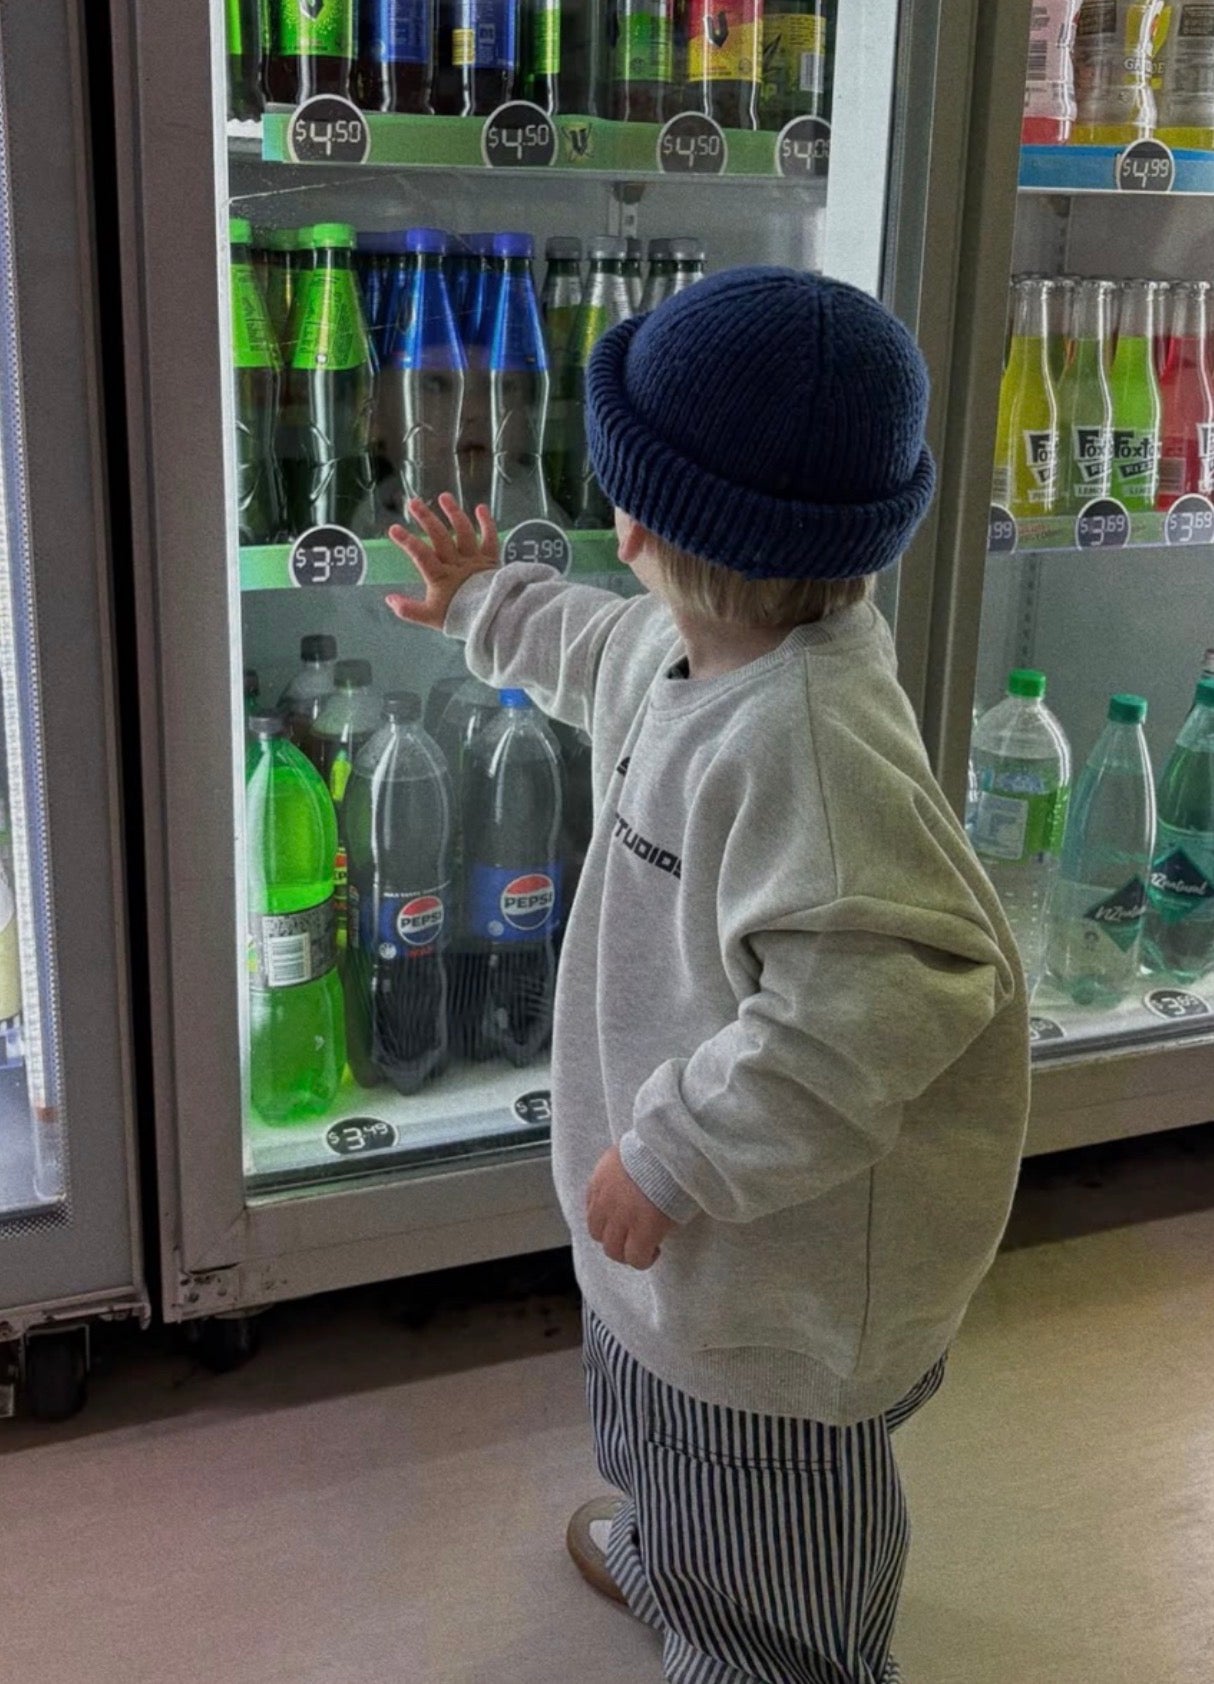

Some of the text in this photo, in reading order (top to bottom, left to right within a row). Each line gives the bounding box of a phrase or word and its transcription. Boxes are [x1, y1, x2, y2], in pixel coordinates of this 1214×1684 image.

[295, 119, 361, 156] $4.50
[487, 124, 550, 160] $4.50
[663, 134, 720, 168] $4.50
[1122, 158, 1170, 188] $4.99
[990, 521, 1013, 540] .99
[1081, 515, 1125, 545] $3.69
[1170, 511, 1213, 542] $3.69
[296, 545, 359, 583] $3.99
[507, 539, 564, 564] $3.99
[503, 891, 553, 909] PEPSI
[328, 1122, 389, 1151] $3.49
